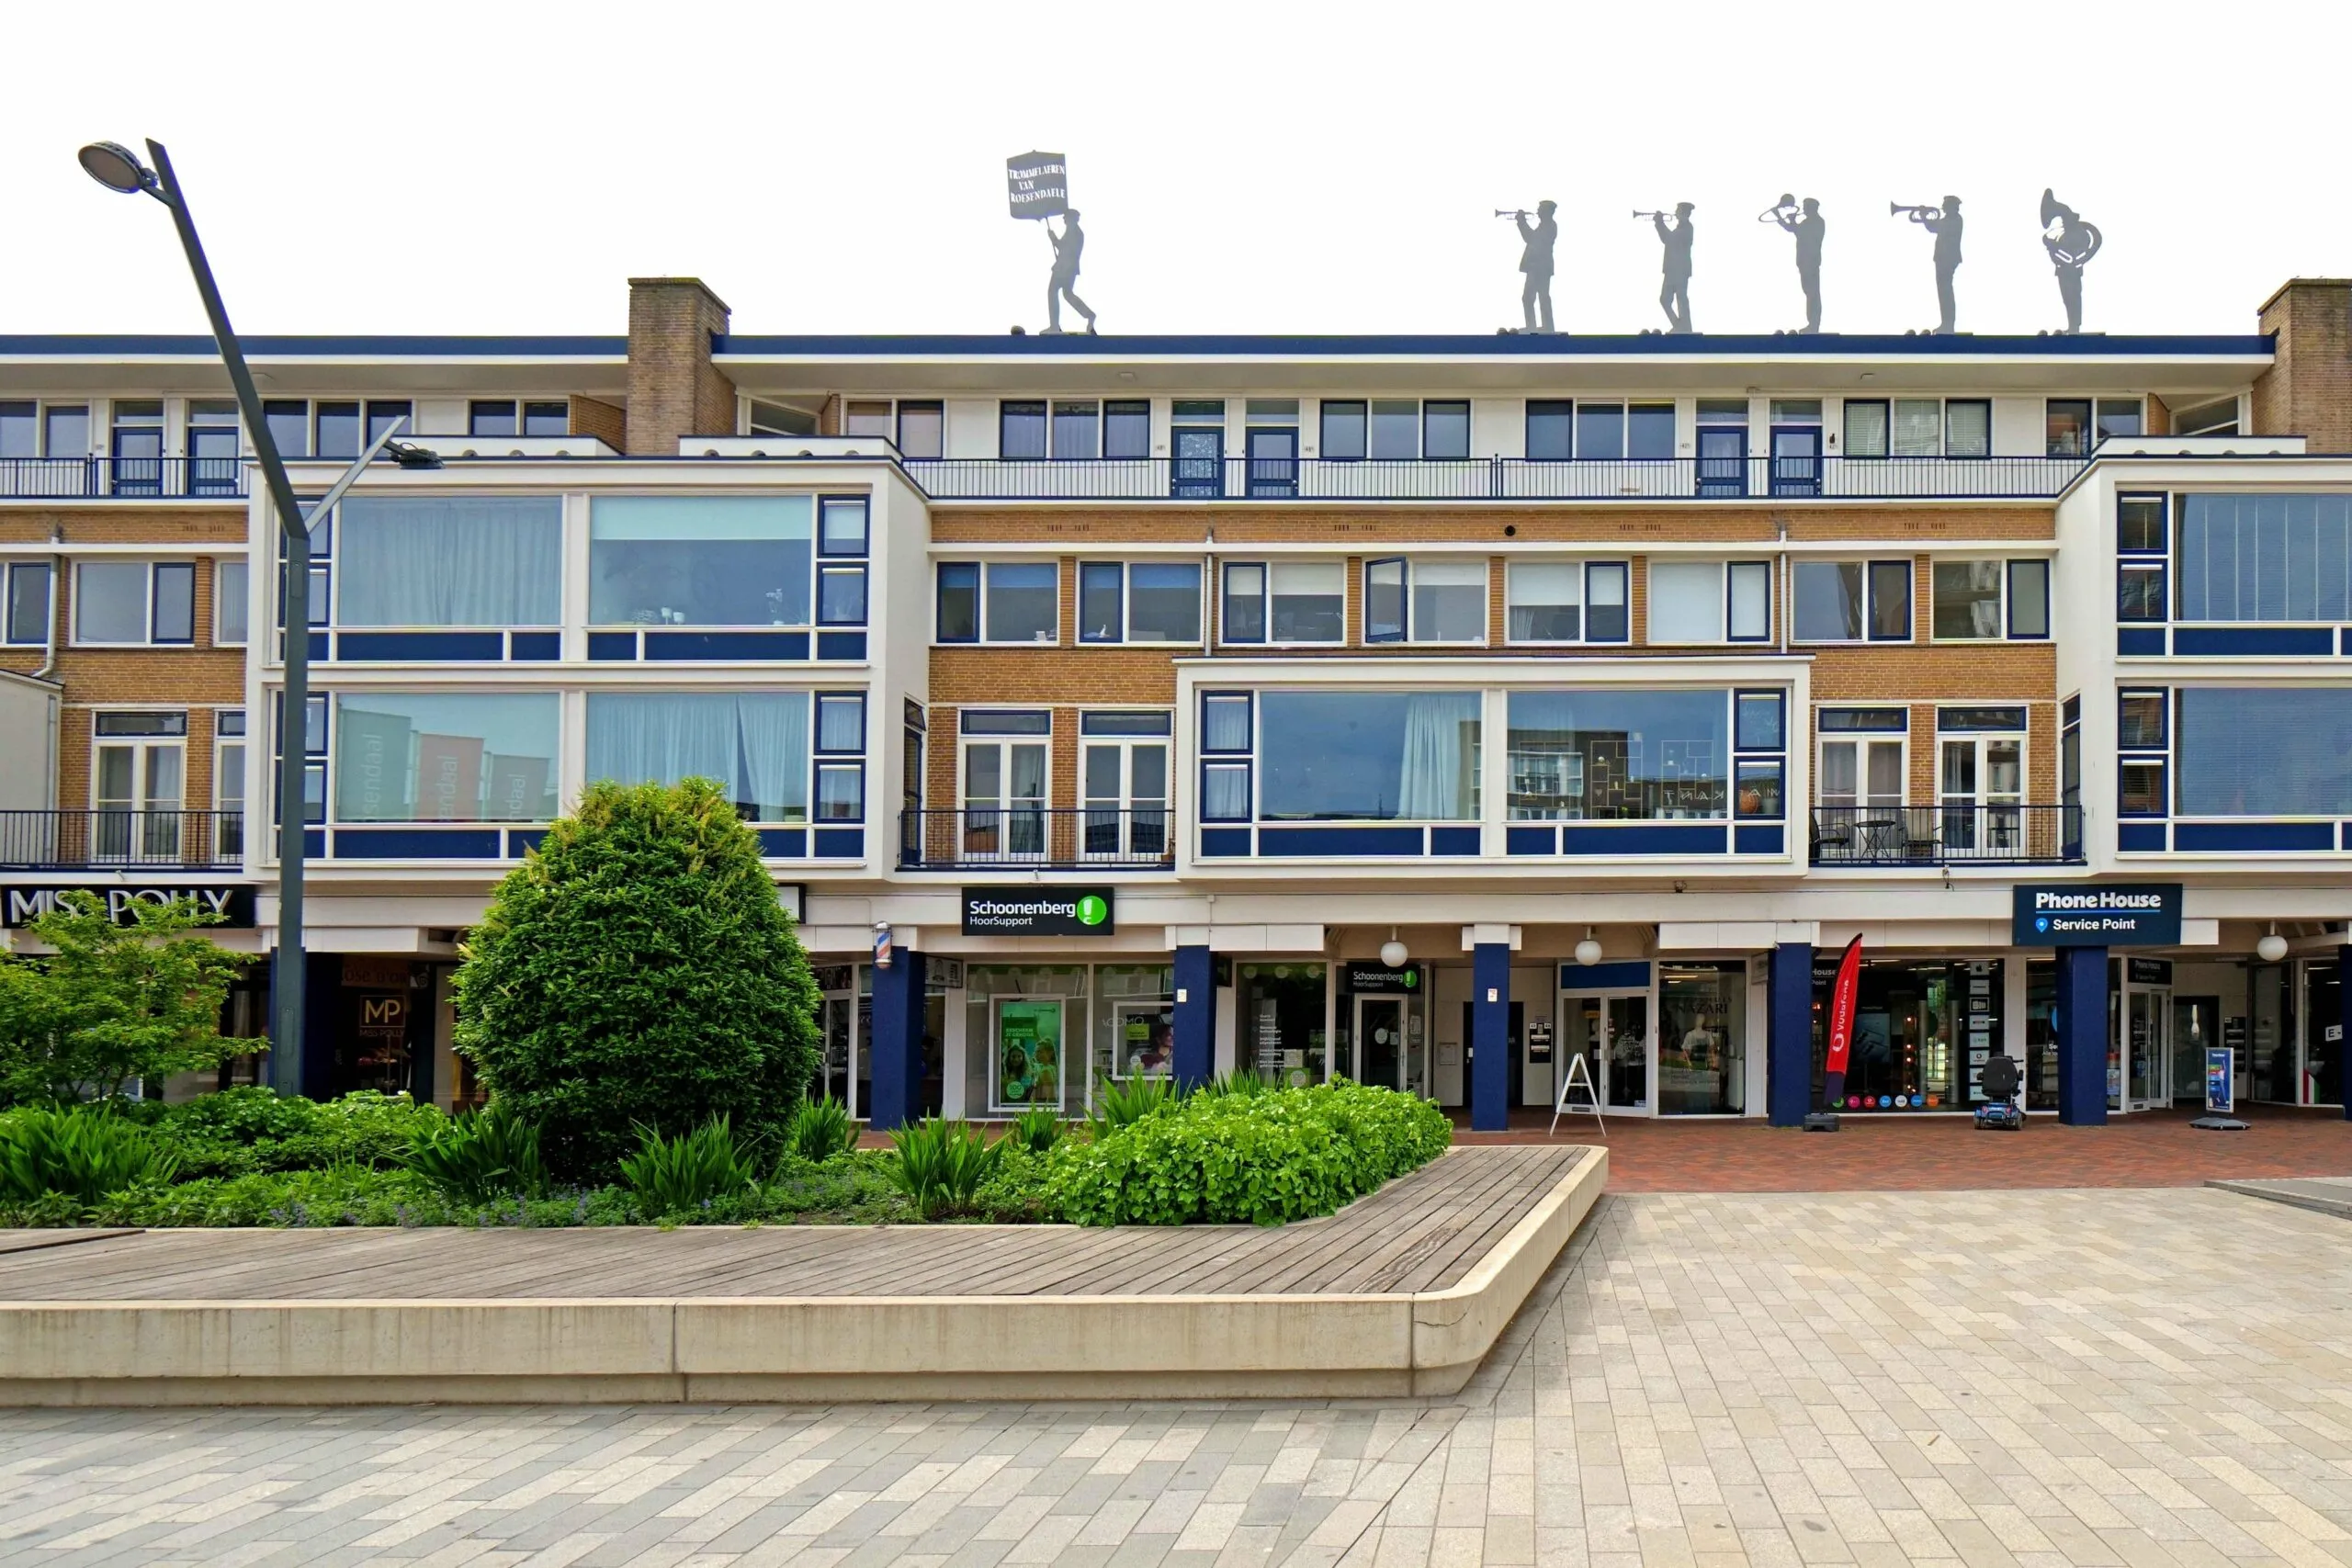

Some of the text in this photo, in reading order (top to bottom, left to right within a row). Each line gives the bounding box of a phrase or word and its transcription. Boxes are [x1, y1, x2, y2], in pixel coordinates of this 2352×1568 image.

[1018, 180, 1035, 190] VAN
[10, 890, 96, 923] MIS
[2036, 891, 2161, 908] Phone House
[969, 900, 1076, 918] Schoonenberg
[969, 916, 1033, 927] HoorSupport
[2052, 919, 2135, 931] Service Point
[1352, 971, 1404, 983] Schoonenberg
[365, 999, 401, 1023] MP
